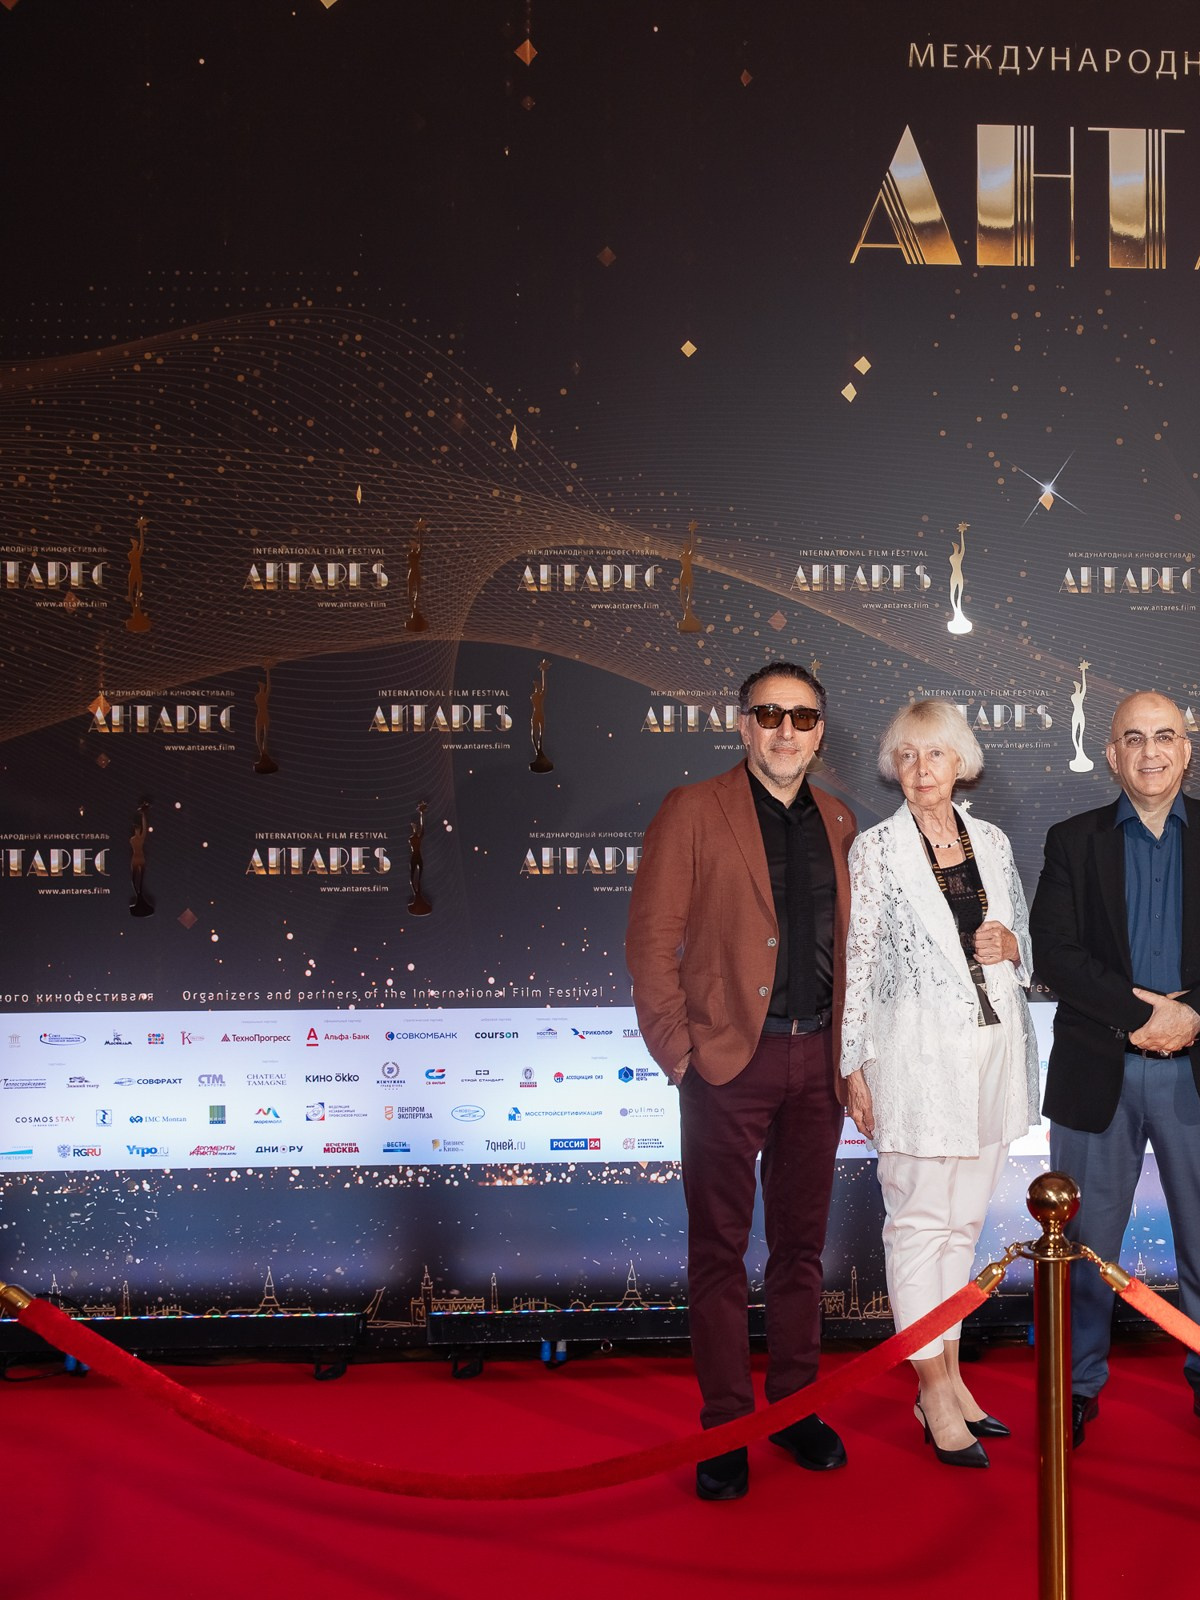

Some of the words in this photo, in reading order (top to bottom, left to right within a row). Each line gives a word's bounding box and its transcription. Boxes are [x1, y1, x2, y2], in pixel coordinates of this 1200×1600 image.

[252, 548, 320, 556] INTERNATIONAL
[325, 548, 344, 556] FILM
[348, 548, 386, 556] FESTIVAL
[800, 549, 865, 557] INTERNATIONAL
[870, 549, 888, 557] FILM
[892, 549, 928, 557] FESTIVAL
[243, 561, 390, 590] ANTARES
[517, 563, 660, 592] АНТАРЕС
[789, 563, 932, 592] ANTARES
[1058, 566, 1197, 593] АНТАРЕС
[590, 602, 660, 610] www.antares.film
[862, 602, 930, 610] www.antares.film
[1129, 604, 1197, 612] www.antares.film
[88, 704, 236, 733] АНТАРЕС
[368, 704, 513, 732] ANTARES
[164, 743, 236, 751] www.antares.film
[246, 846, 392, 875] ANTARES
[520, 846, 642, 875] АНТАРЕ
[38, 887, 111, 895] www.antares.film
[37, 991, 154, 1004] кинофестиваля
[182, 989, 260, 1003] Organizers
[267, 989, 291, 999] and
[298, 989, 358, 1002] partners
[364, 989, 378, 999] of
[384, 988, 406, 999] the
[413, 987, 505, 999] International
[513, 987, 542, 998] Film
[549, 986, 604, 997] Festival
[231, 1033, 291, 1043] ТехноПрогресс
[396, 1032, 458, 1040] СОВКОМБАНК
[475, 1031, 519, 1039] courson
[305, 1075, 332, 1083] КИНО
[397, 1112, 433, 1120] ЭКСПЕРТИЗА
[553, 1140, 585, 1148] РОССИЯ
[589, 1140, 600, 1148] 24
[73, 1148, 102, 1157] RGRU
